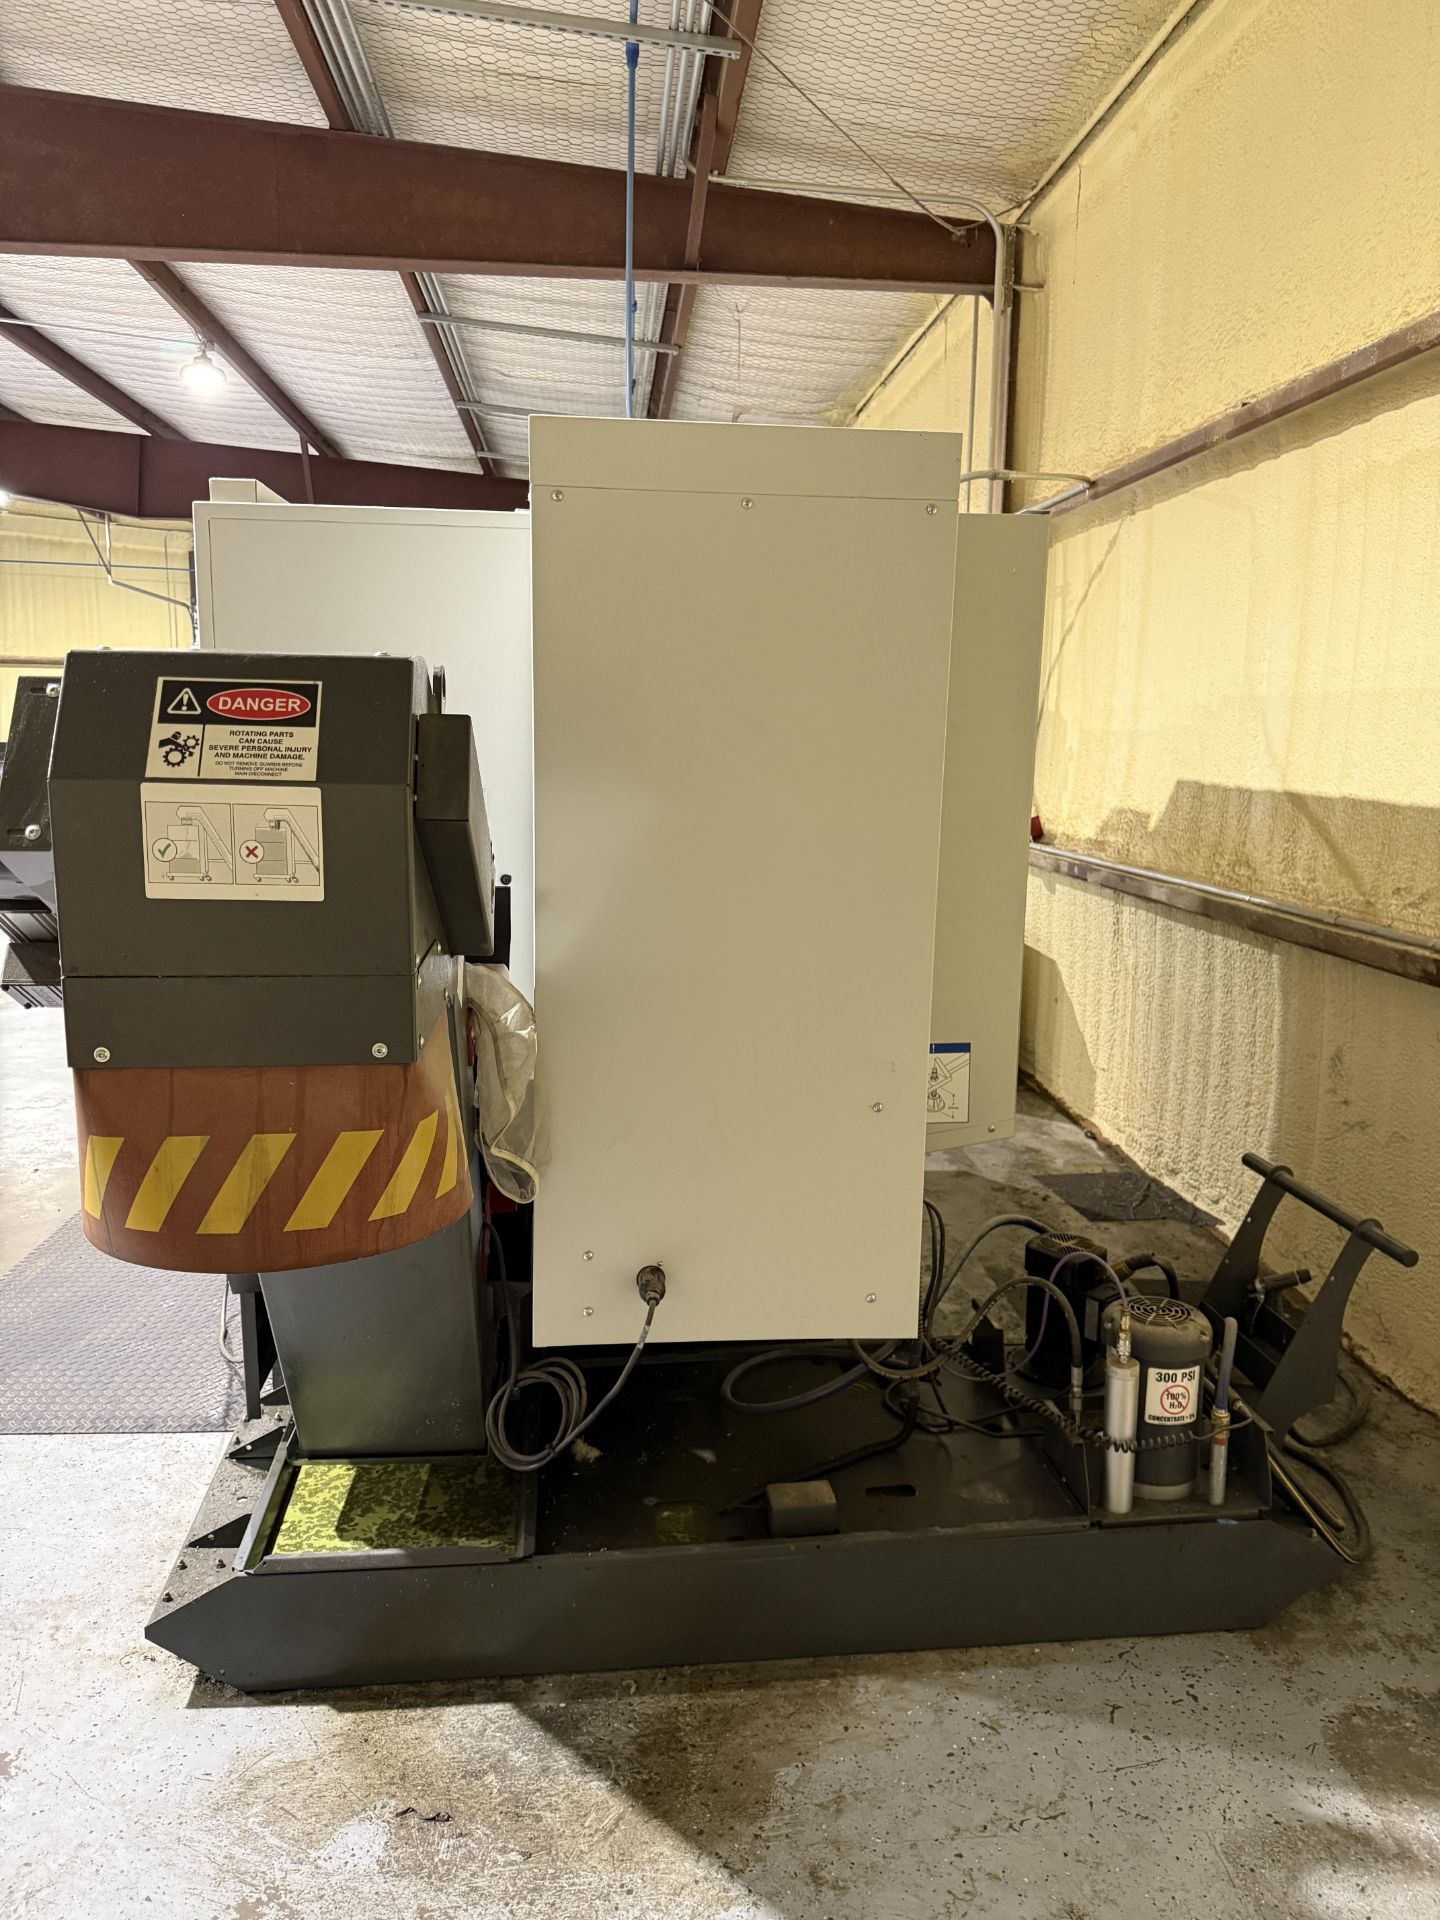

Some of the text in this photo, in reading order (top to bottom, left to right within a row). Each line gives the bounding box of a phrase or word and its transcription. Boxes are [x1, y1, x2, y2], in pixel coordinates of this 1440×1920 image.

[218, 697, 301, 712] DANGER
[1156, 1370, 1196, 1383] 300 PSI
[1166, 1392, 1186, 1400] 100%
